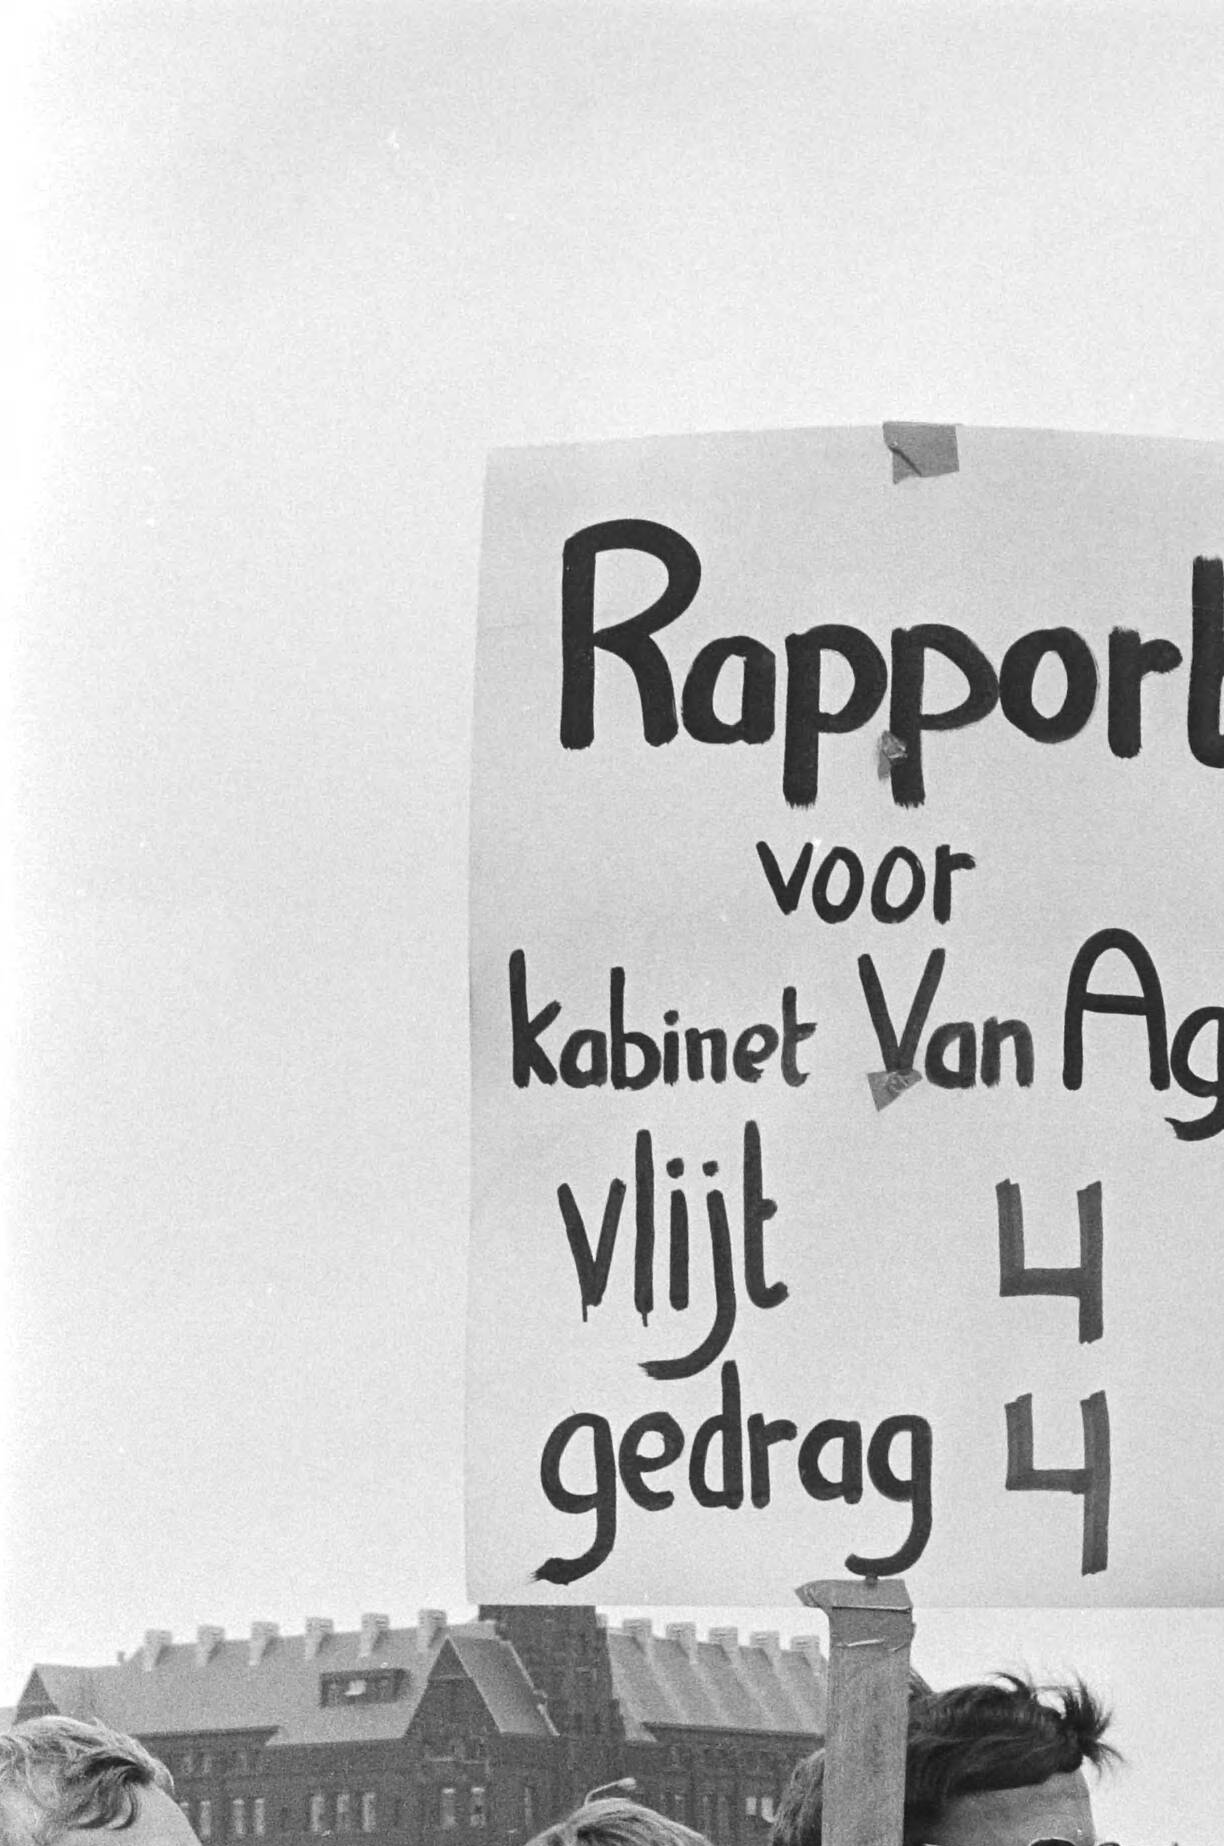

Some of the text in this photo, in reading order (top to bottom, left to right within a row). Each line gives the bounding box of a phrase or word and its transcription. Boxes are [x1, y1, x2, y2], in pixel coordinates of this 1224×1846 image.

[755, 839, 978, 926] voor
[508, 949, 818, 1090] kabinet
[857, 948, 1036, 1090] Van
[557, 1119, 1104, 1380] vlijt 4
[531, 1360, 1111, 1588] gedrag 4
